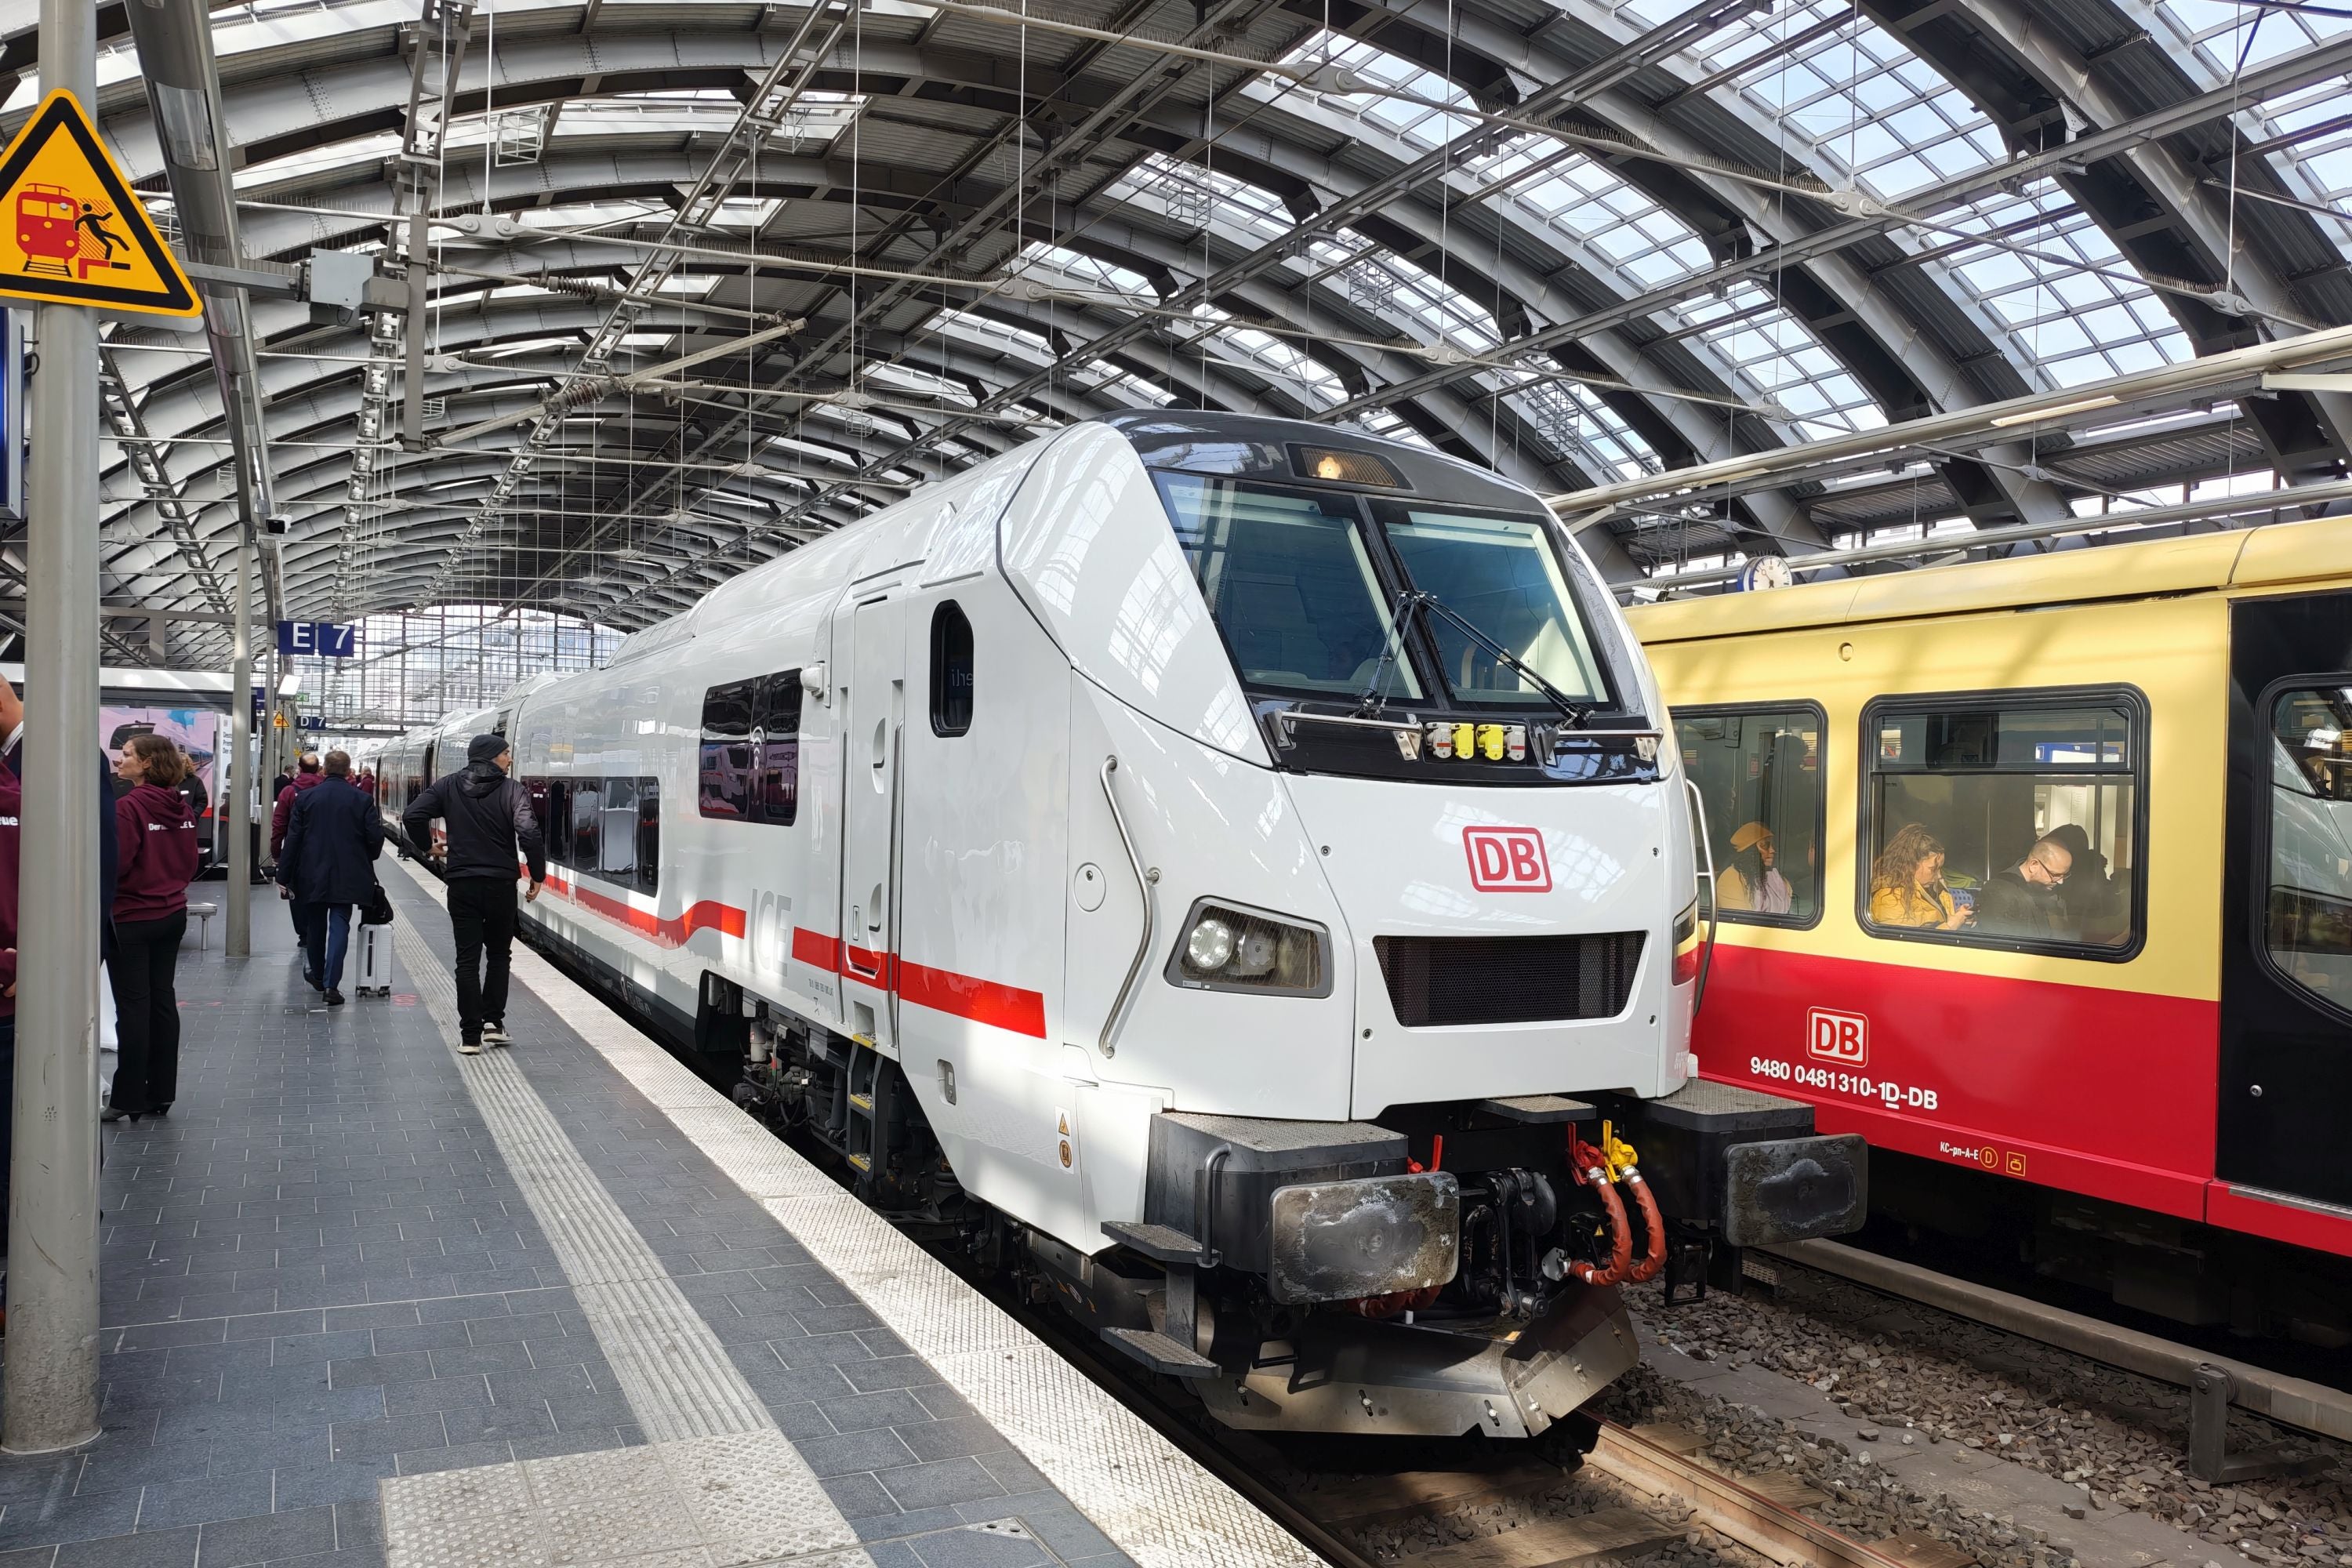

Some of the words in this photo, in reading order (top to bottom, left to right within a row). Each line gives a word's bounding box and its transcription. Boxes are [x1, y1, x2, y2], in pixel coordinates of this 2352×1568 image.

[292, 622, 311, 648] E
[332, 624, 350, 650] 7
[300, 716, 310, 727] D
[317, 717, 325, 728] 7
[1474, 837, 1541, 881] DB
[748, 887, 793, 978] ICE
[1815, 1017, 1860, 1056] DB
[1750, 1056, 1791, 1080] 9480
